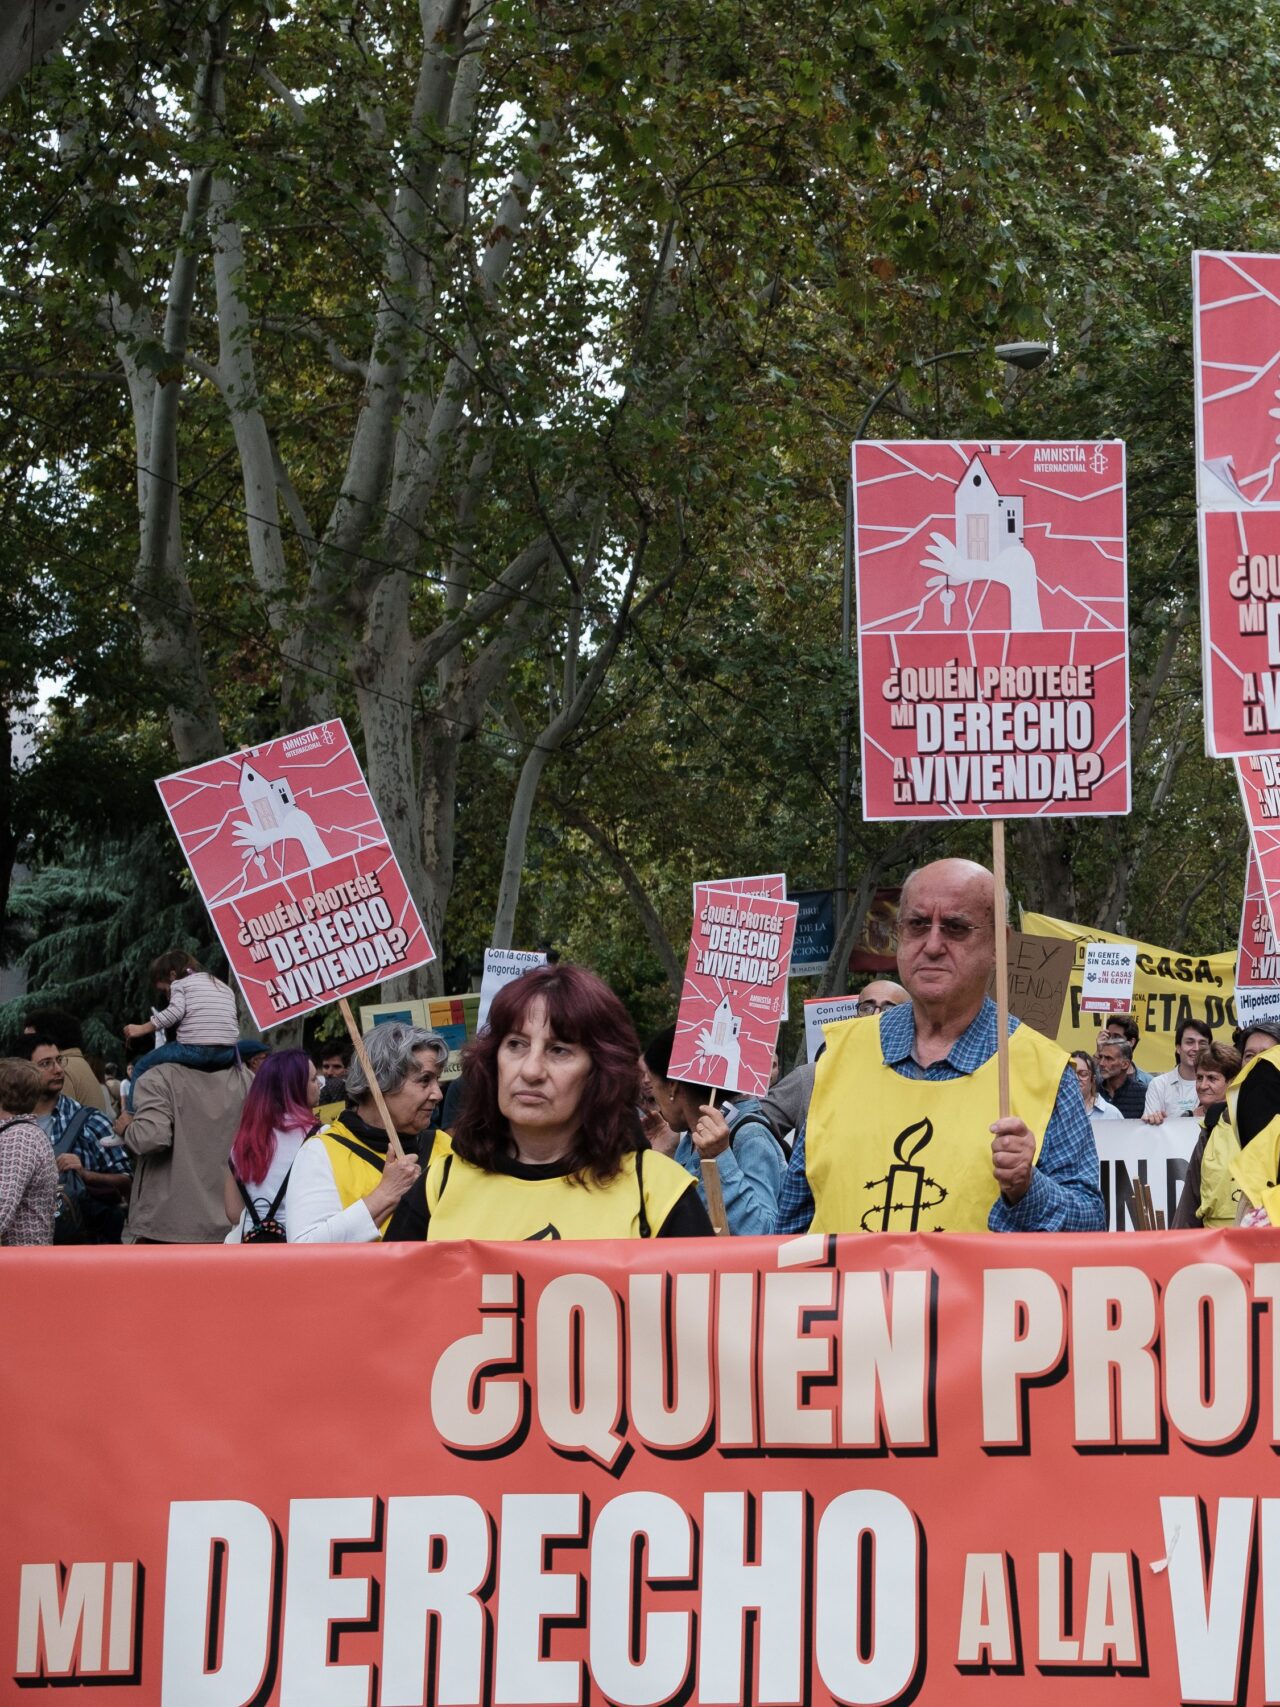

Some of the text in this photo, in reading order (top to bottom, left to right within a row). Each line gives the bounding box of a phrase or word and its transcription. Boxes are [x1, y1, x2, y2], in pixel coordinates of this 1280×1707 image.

[1034, 446, 1086, 463] AMNISTÍA
[1034, 463, 1087, 474] INTERNACIONAL
[1239, 602, 1267, 635] MI
[882, 658, 1095, 702] ¿QUIÉN PROTEGE
[1243, 672, 1259, 704] A
[890, 701, 1093, 754] MI DERECHO
[1243, 705, 1267, 735] LA
[282, 730, 319, 751] AMNISTÍA
[285, 741, 323, 758] INTERNACIONAL
[893, 752, 1104, 805] A LA VIVIENDA?
[237, 871, 384, 947] ¿QUIÉN PROTEGE
[700, 904, 785, 935] ¿QUIÉN PROTEGE
[799, 906, 817, 916] UBRE
[249, 896, 394, 974] MI DERECHO
[701, 921, 780, 960] MI DERECHO
[801, 923, 826, 933] DE LA
[1254, 929, 1265, 944] MI
[264, 926, 408, 1013] A LA VIVIENDA?
[516, 952, 541, 964] crisis,
[695, 949, 780, 987] A LA VIVIENDA?
[798, 965, 823, 973] MADRID
[1008, 941, 1062, 973] EY
[1136, 953, 1223, 988] CASA,
[1252, 958, 1258, 969] A
[1251, 968, 1259, 979] LA
[816, 1005, 835, 1016] Con
[1240, 993, 1280, 1009] ¡Hipotecas
[812, 1014, 857, 1027] engordam
[430, 1234, 938, 1479] ¿QUIÉN
[14, 1558, 147, 1688] MI
[160, 1488, 928, 1707] DERECHO
[956, 1550, 1018, 1677] A
[1033, 1550, 1150, 1679] LA
